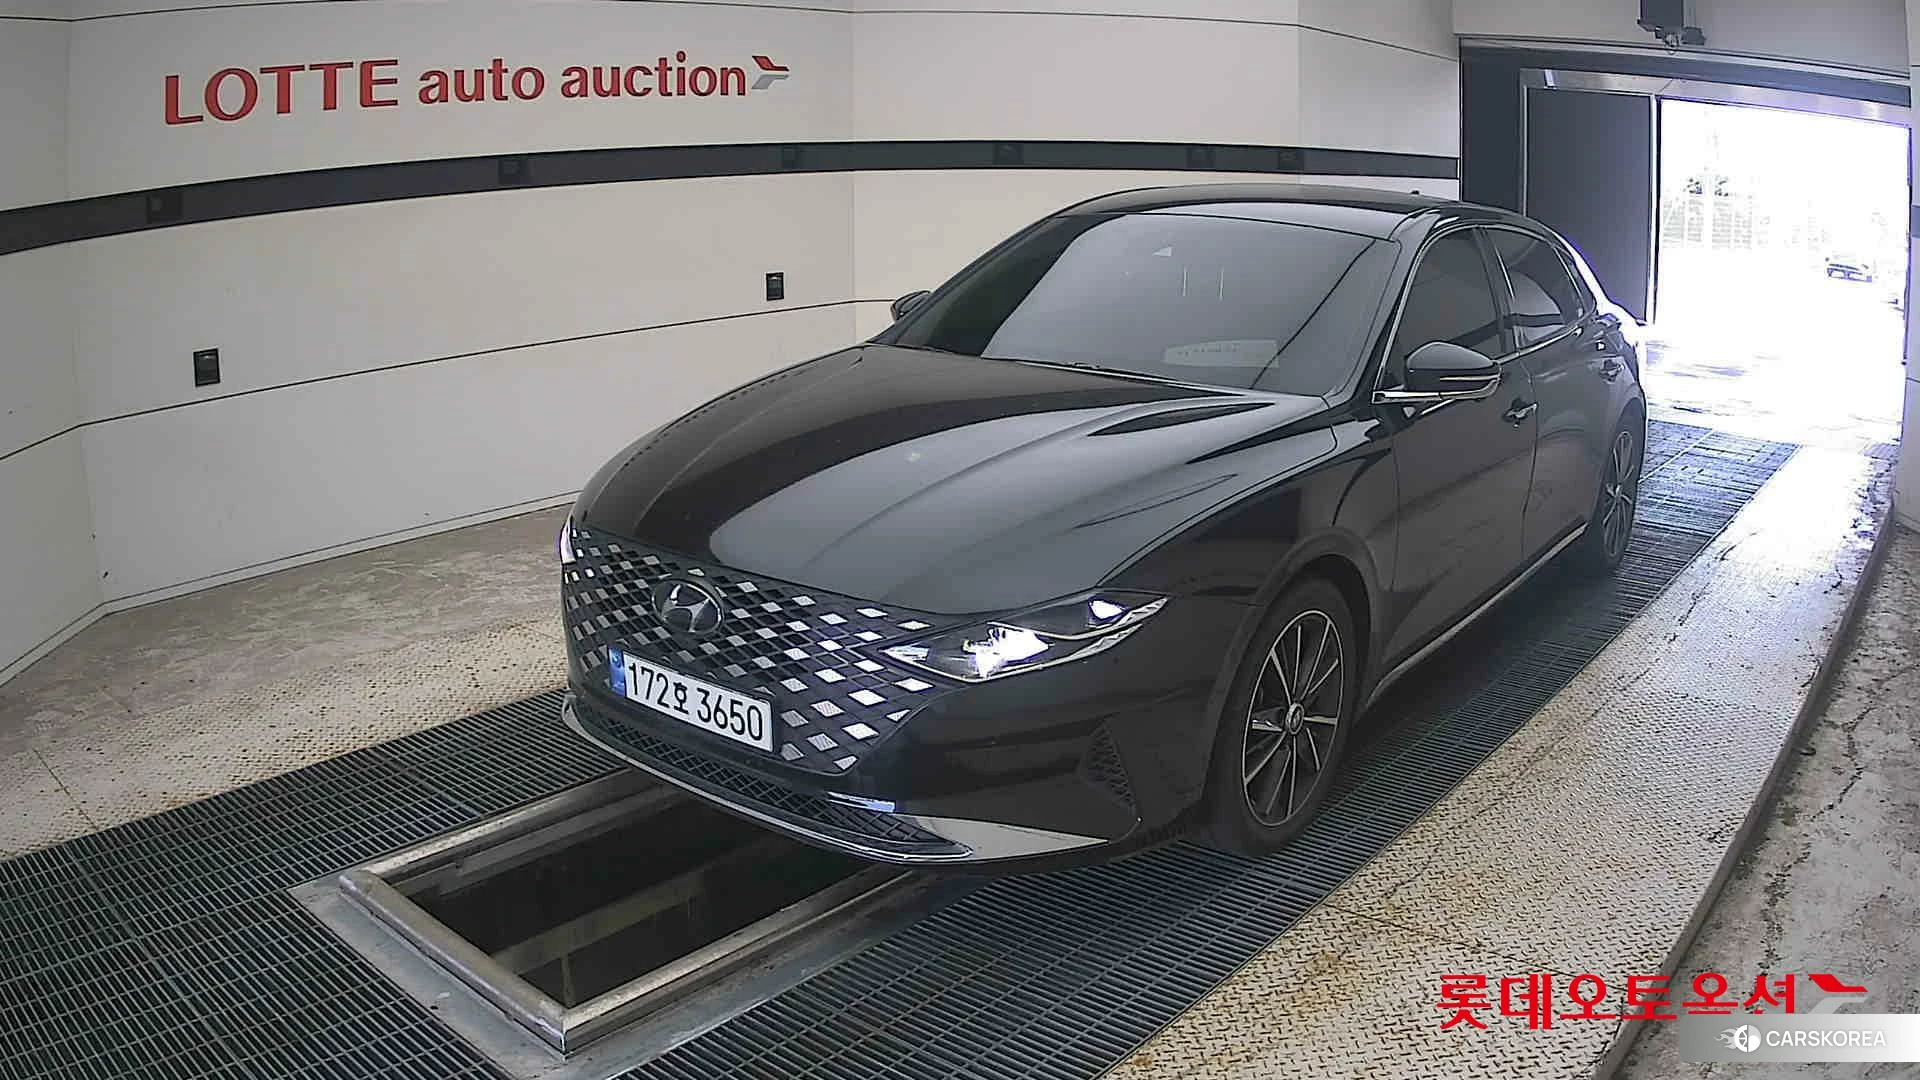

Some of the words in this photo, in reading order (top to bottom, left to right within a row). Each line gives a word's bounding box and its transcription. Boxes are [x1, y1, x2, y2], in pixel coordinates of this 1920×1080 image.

[165, 59, 398, 125] LOTTE
[418, 58, 545, 104] auto
[561, 51, 746, 97] auction
[628, 662, 689, 715] 172호
[697, 687, 762, 741] 3650
